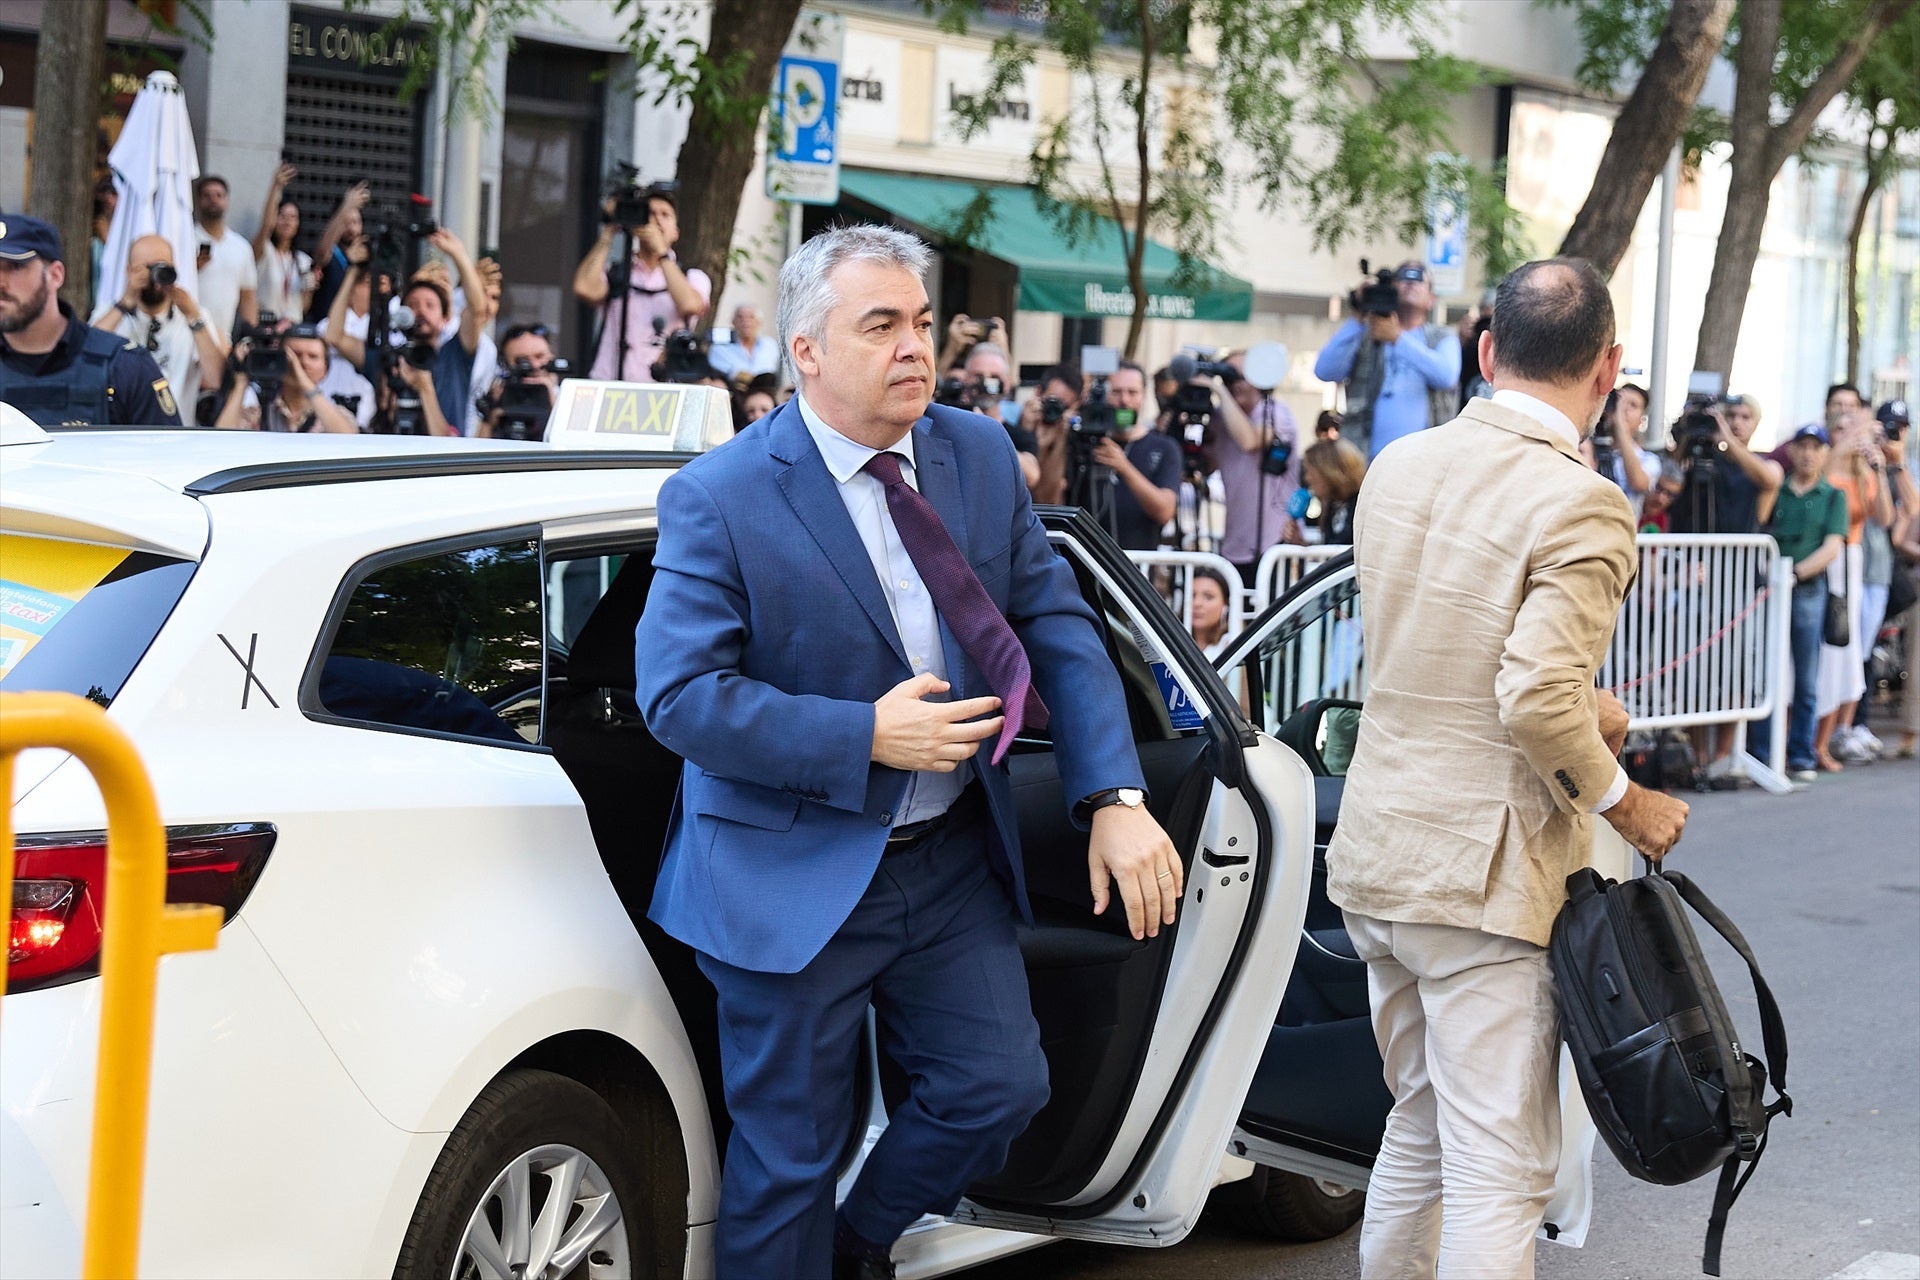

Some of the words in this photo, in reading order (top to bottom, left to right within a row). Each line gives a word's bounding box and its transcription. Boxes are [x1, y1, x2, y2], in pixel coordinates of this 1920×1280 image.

[289, 22, 317, 57] EL
[604, 390, 679, 432] TAXI
[217, 633, 280, 709] X
